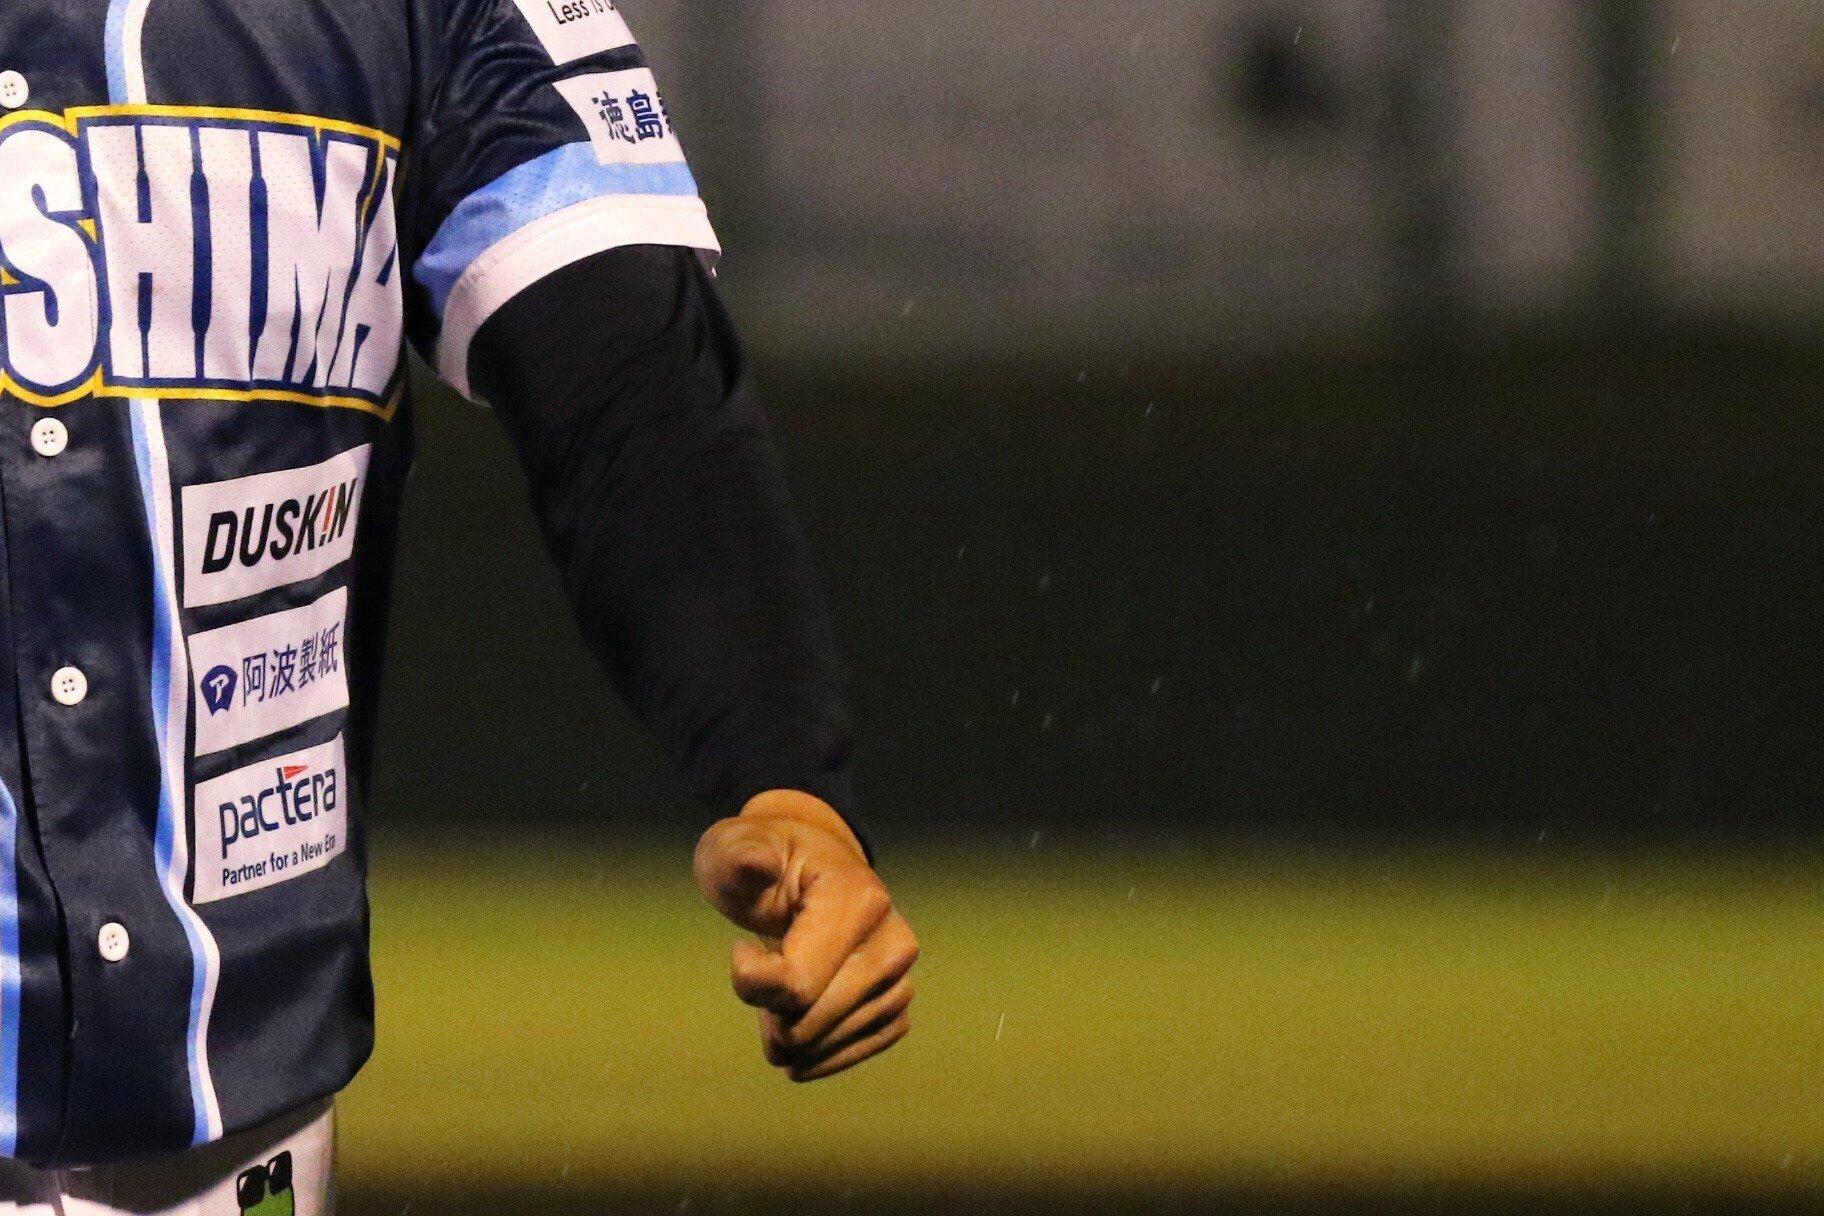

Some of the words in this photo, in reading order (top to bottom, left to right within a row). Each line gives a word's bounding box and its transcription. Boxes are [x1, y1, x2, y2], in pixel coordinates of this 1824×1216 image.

[546, 0, 590, 25] Less
[242, 621, 340, 707] 阿波製紙
[218, 767, 336, 860] pactera
[222, 860, 266, 887] Partner
[270, 852, 289, 872] for
[292, 851, 299, 866] a
[301, 840, 323, 862] New
